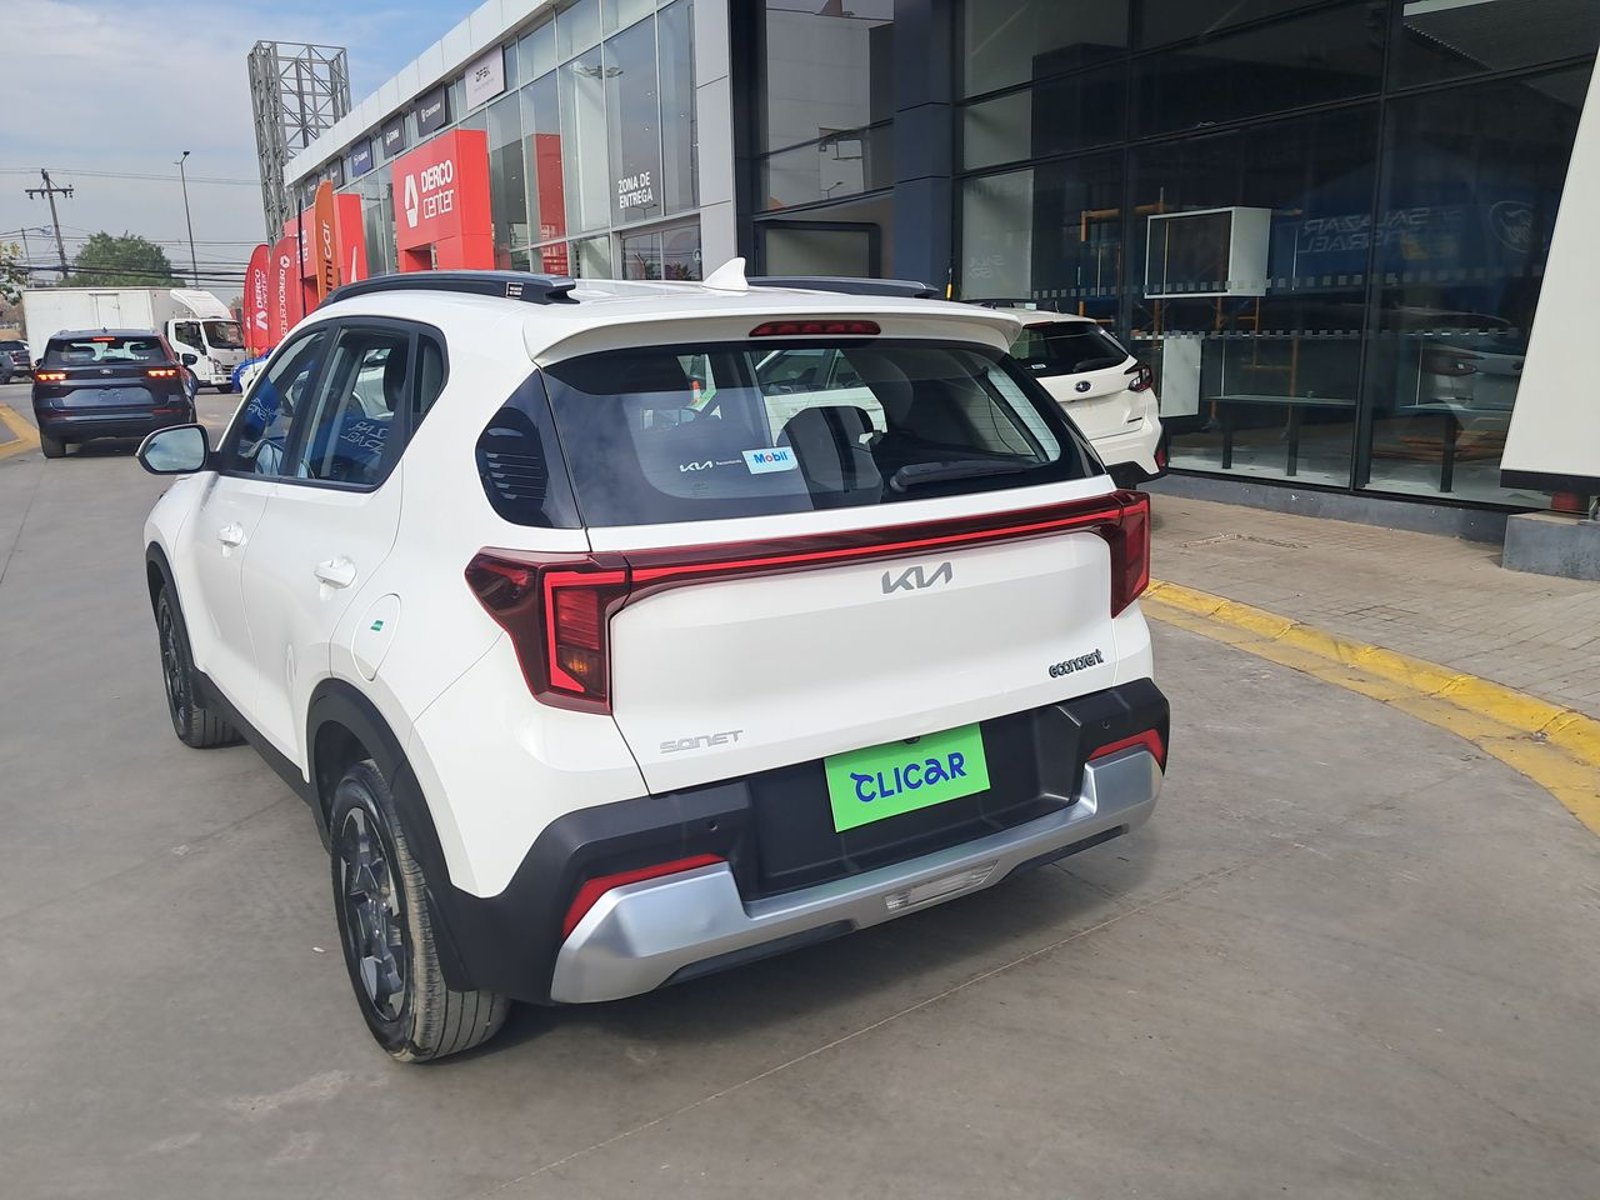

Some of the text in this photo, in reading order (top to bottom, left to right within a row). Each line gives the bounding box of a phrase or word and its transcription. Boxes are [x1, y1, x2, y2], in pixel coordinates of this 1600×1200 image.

[421, 160, 453, 193] DERCO
[618, 171, 650, 194] ZONA DE
[620, 187, 653, 209] ENTREGA
[680, 460, 714, 472] KIA
[754, 451, 788, 464] Mobil
[882, 562, 953, 594] KIA
[1049, 648, 1104, 678] econorent
